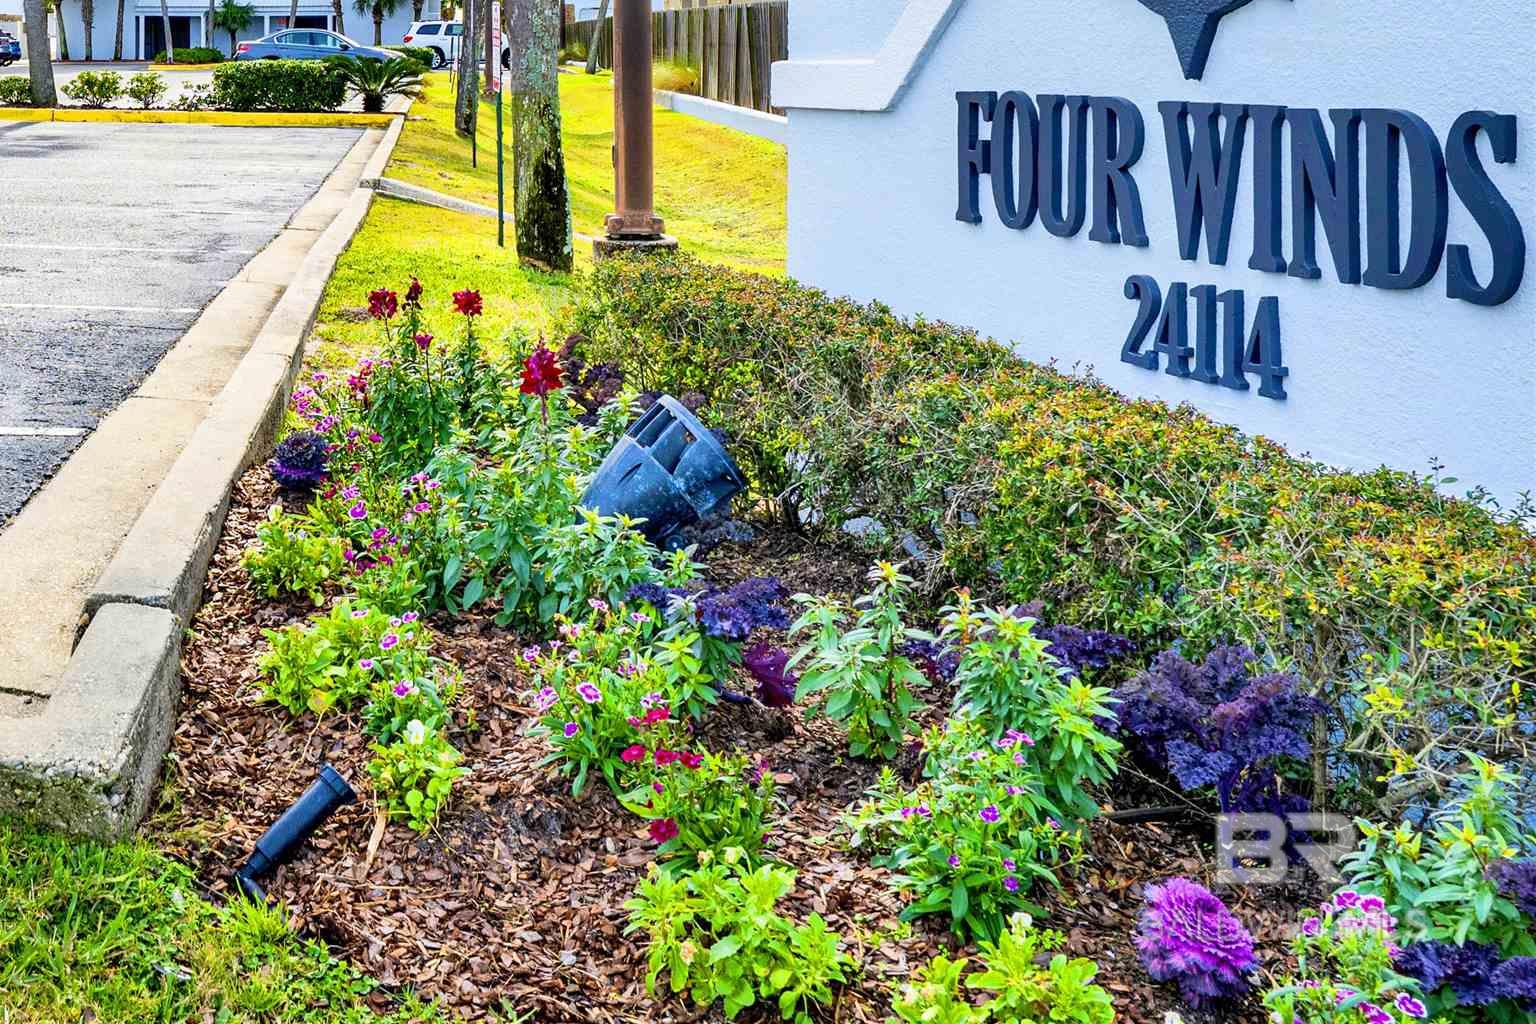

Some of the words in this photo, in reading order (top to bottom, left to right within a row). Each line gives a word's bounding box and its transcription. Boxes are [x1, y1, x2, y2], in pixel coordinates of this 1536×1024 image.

[955, 90, 1149, 248] FOUR
[1157, 100, 1526, 307] WINDS
[1120, 274, 1289, 401] 24114
